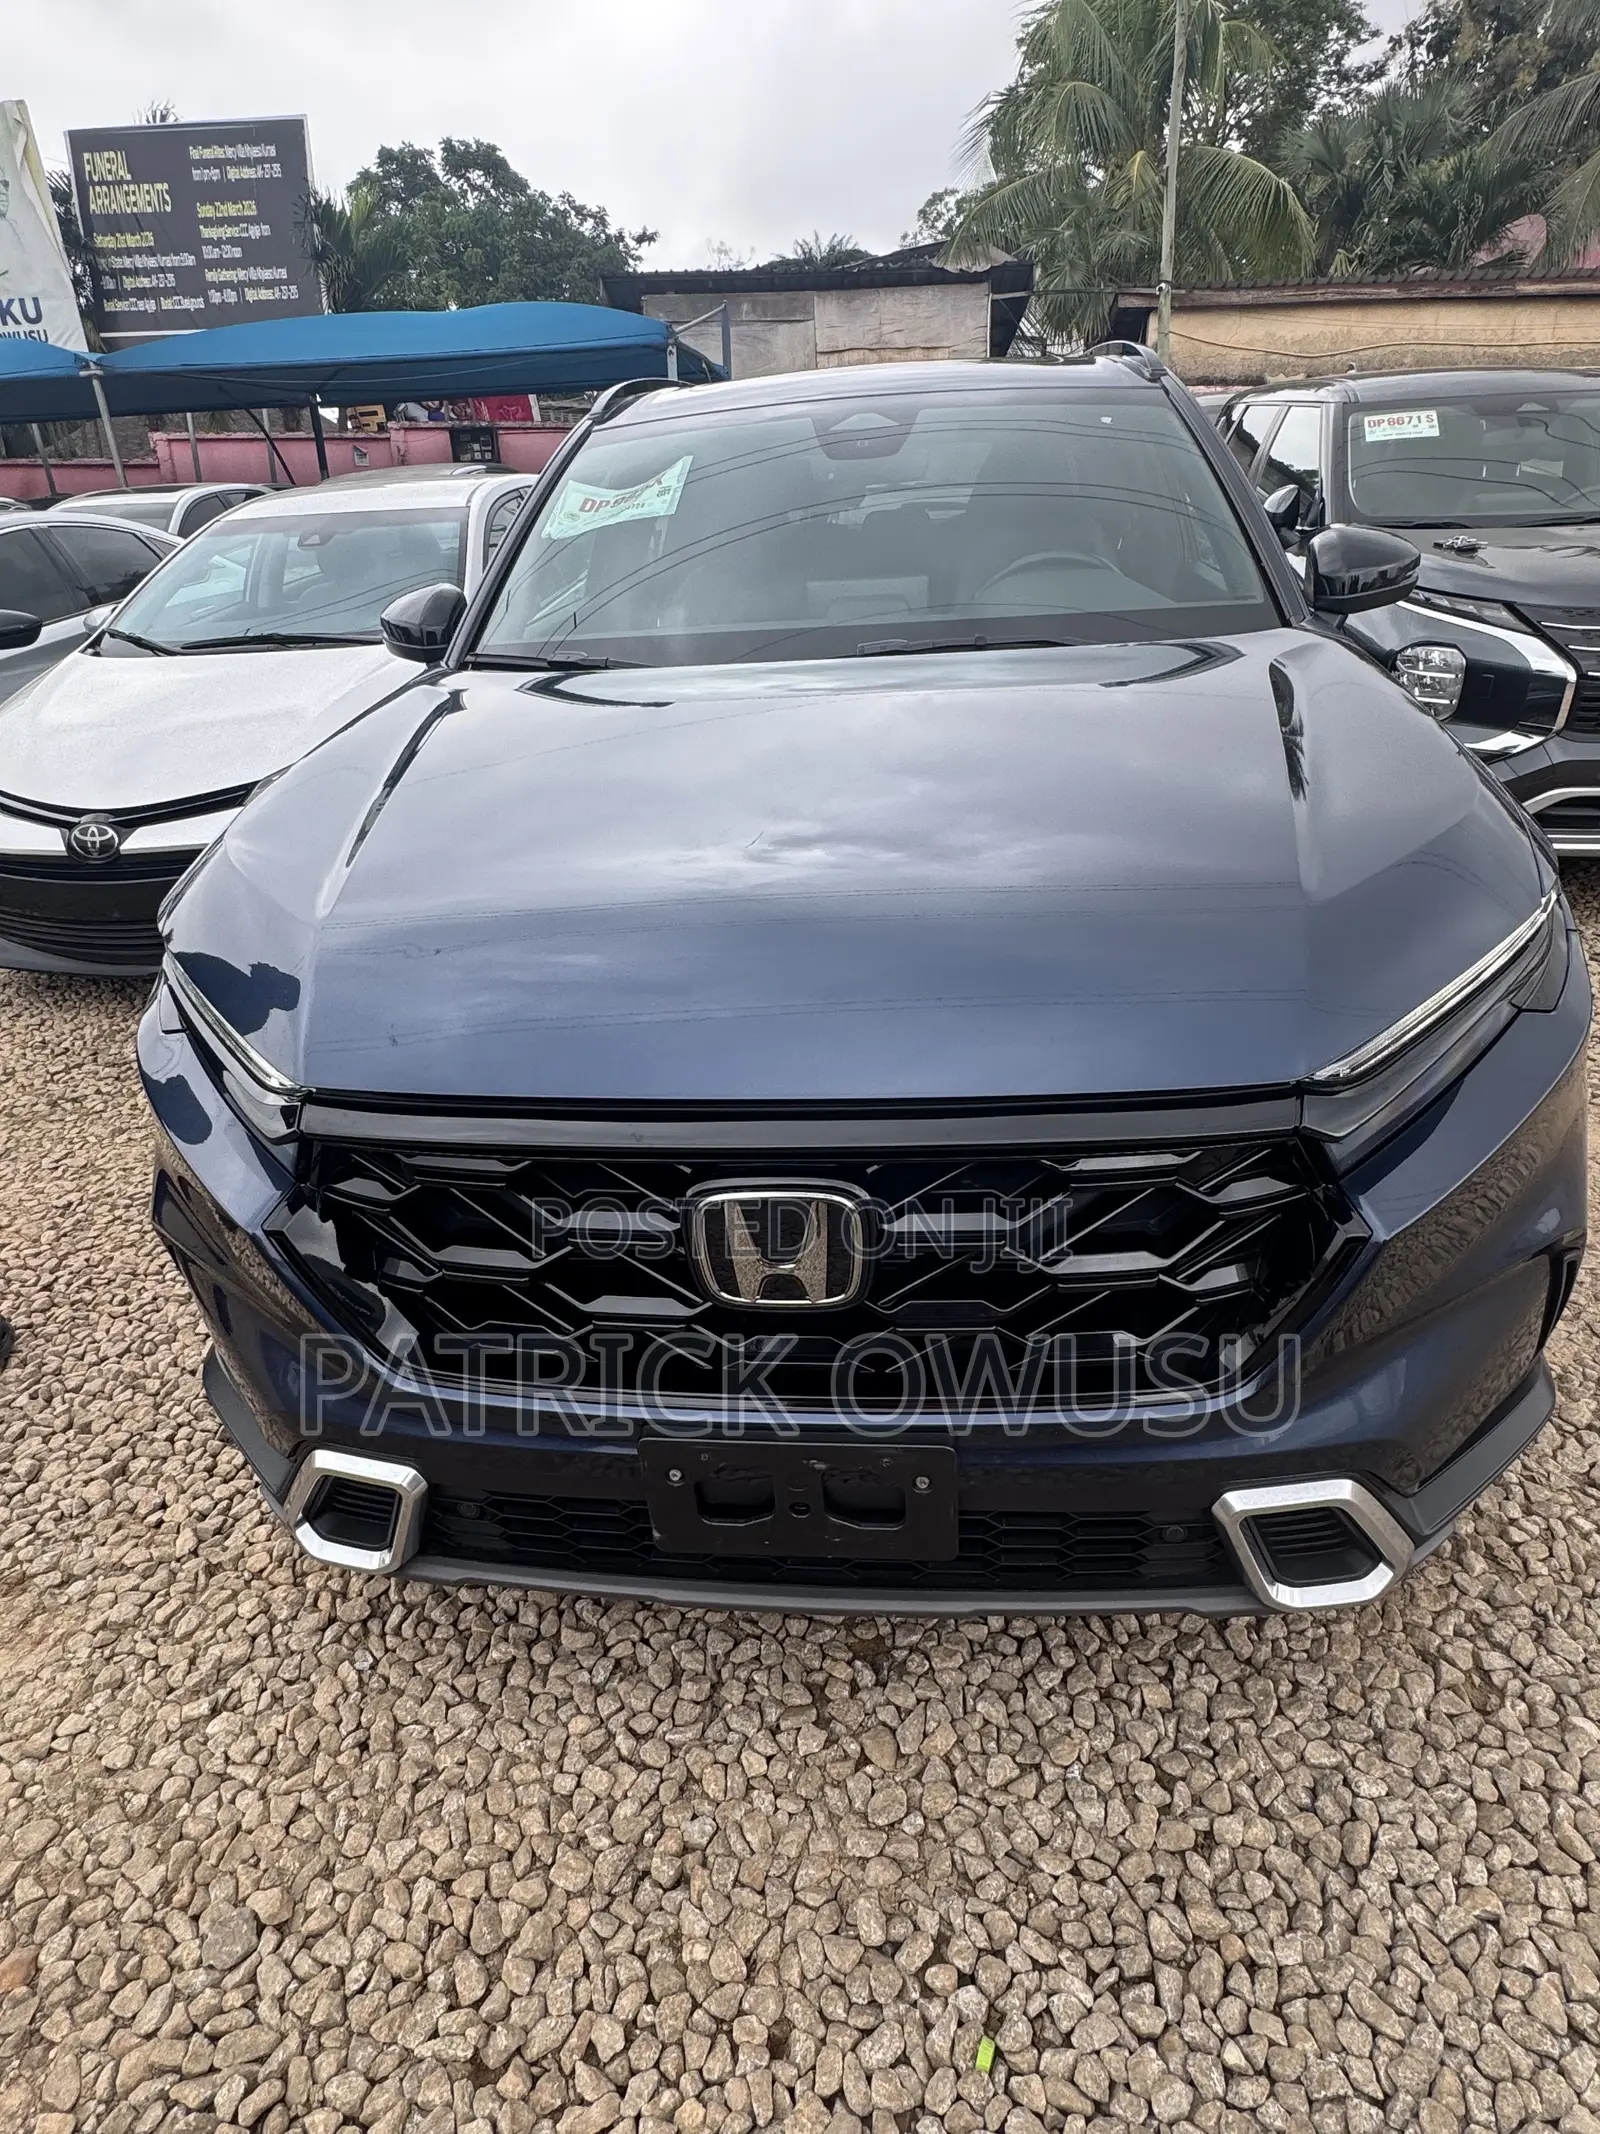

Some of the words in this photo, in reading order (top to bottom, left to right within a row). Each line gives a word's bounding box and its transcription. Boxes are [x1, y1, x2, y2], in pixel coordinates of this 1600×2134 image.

[83, 150, 132, 182] FUNERAL
[89, 182, 172, 215] ARRANGEMENTS
[196, 202, 216, 220] Sunday
[227, 200, 243, 217] March
[93, 232, 117, 251] Saturday
[126, 231, 141, 248] March
